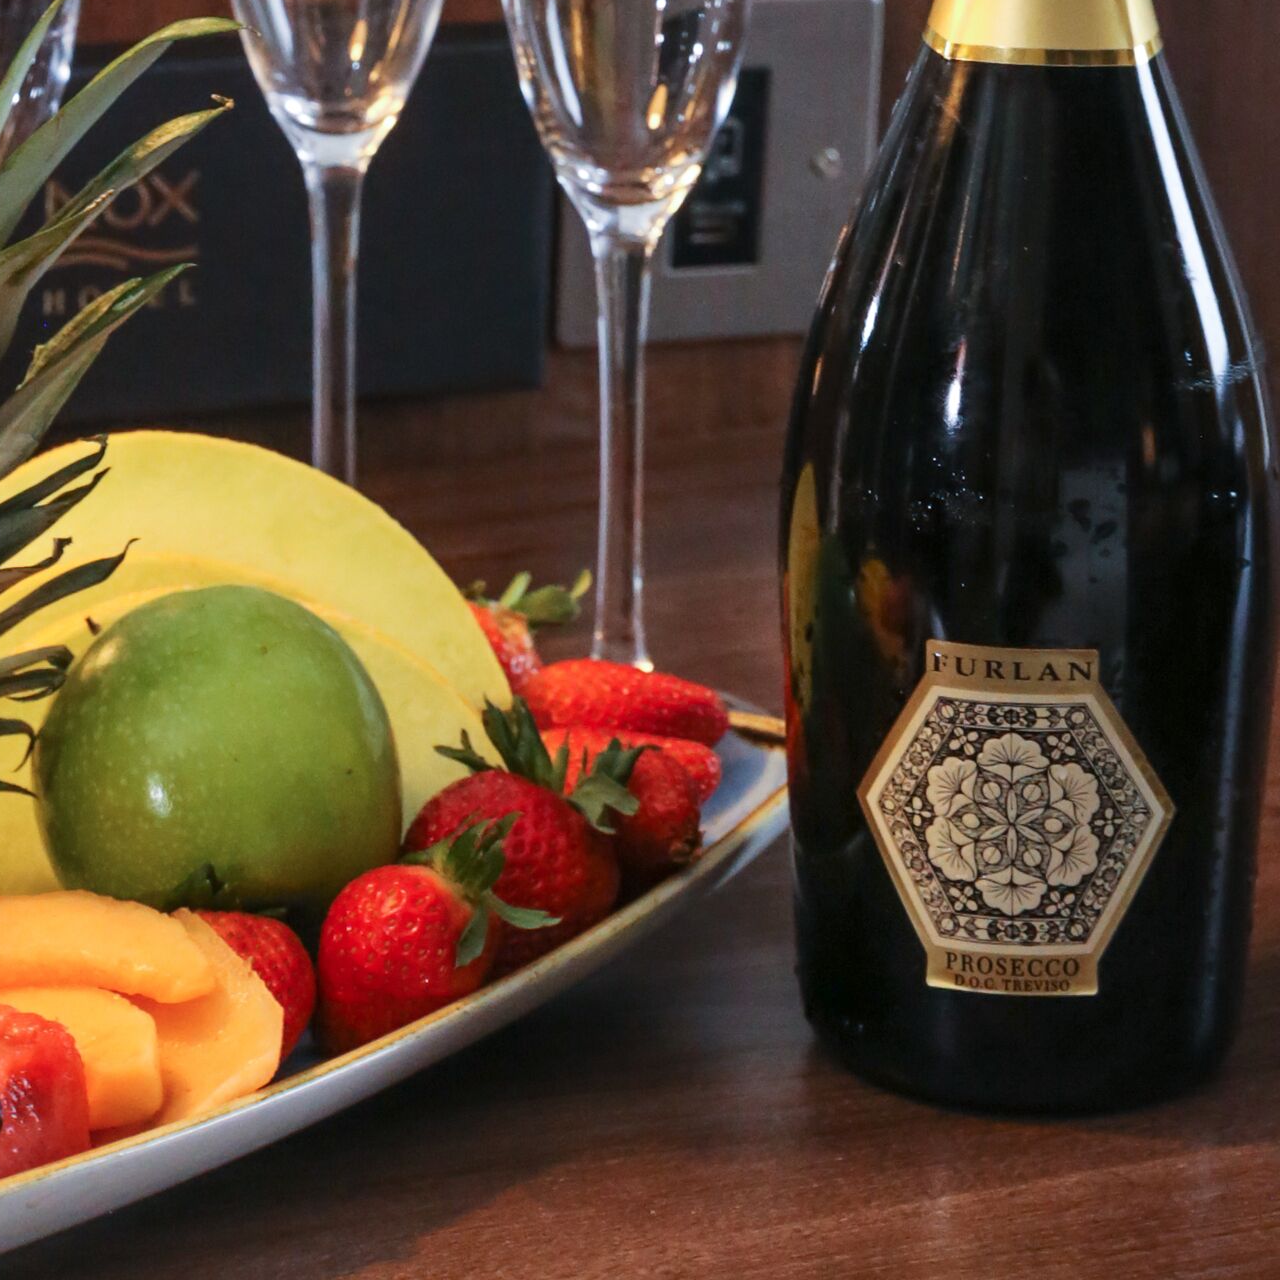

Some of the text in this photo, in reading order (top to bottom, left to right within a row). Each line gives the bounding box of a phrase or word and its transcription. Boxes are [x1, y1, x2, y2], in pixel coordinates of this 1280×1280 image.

[930, 652, 1095, 683] FURLAN
[945, 951, 1080, 978] PROSECCO
[954, 974, 1070, 992] D.O.C. TREVISO
